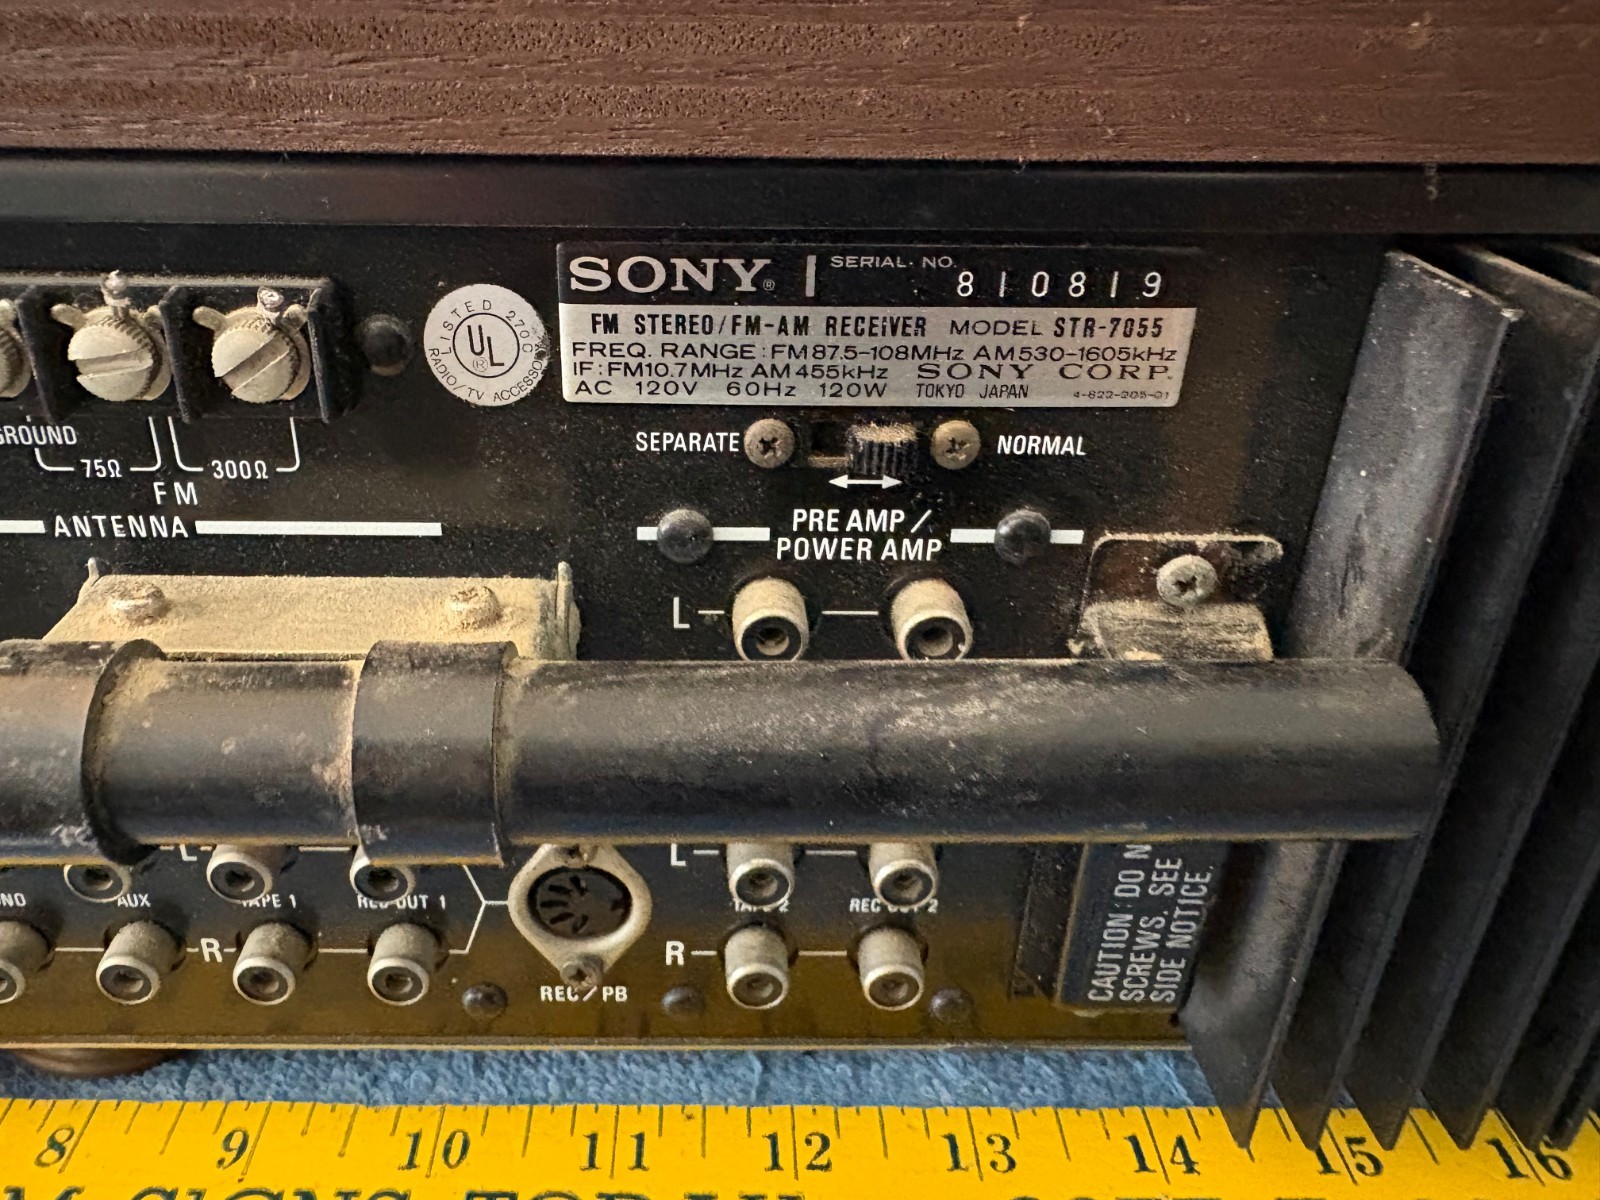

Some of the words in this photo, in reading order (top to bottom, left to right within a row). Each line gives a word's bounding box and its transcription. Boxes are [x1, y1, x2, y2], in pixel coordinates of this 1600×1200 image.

[830, 255, 907, 268] SERIAL
[922, 256, 957, 268] NO.
[440, 299, 492, 355] LISTED
[591, 313, 619, 334] FM
[825, 315, 927, 337] RECEIVER
[950, 320, 1043, 336] MODEL
[1053, 317, 1164, 338] STR-7055
[467, 324, 505, 366] UL
[917, 363, 1034, 380] SONY
[1058, 364, 1174, 380] CORP.
[575, 381, 612, 395] AC
[637, 381, 697, 395] 120V
[726, 382, 796, 397] 60Hz
[820, 382, 887, 398] 120W
[916, 383, 965, 399] TOKYO
[979, 383, 1029, 399] JAPAN
[635, 432, 740, 453] SEPARATE
[996, 435, 1087, 456] NORMAL
[153, 481, 198, 506] FM
[53, 515, 189, 538] ANTENNA
[792, 509, 839, 533] PRE
[776, 538, 872, 561] POWER
[880, 538, 942, 562] AMP
[673, 597, 690, 629] L
[670, 843, 686, 867] L
[1113, 869, 1146, 898] DO
[1148, 857, 1183, 897] SEE
[117, 893, 151, 908] AUX
[289, 894, 296, 908] 1
[440, 895, 446, 909] 1
[201, 937, 223, 962] R
[665, 941, 685, 966] R
[1149, 957, 1187, 1003] SIDE
[34, 1127, 75, 1168] 8
[216, 1128, 250, 1169] 9
